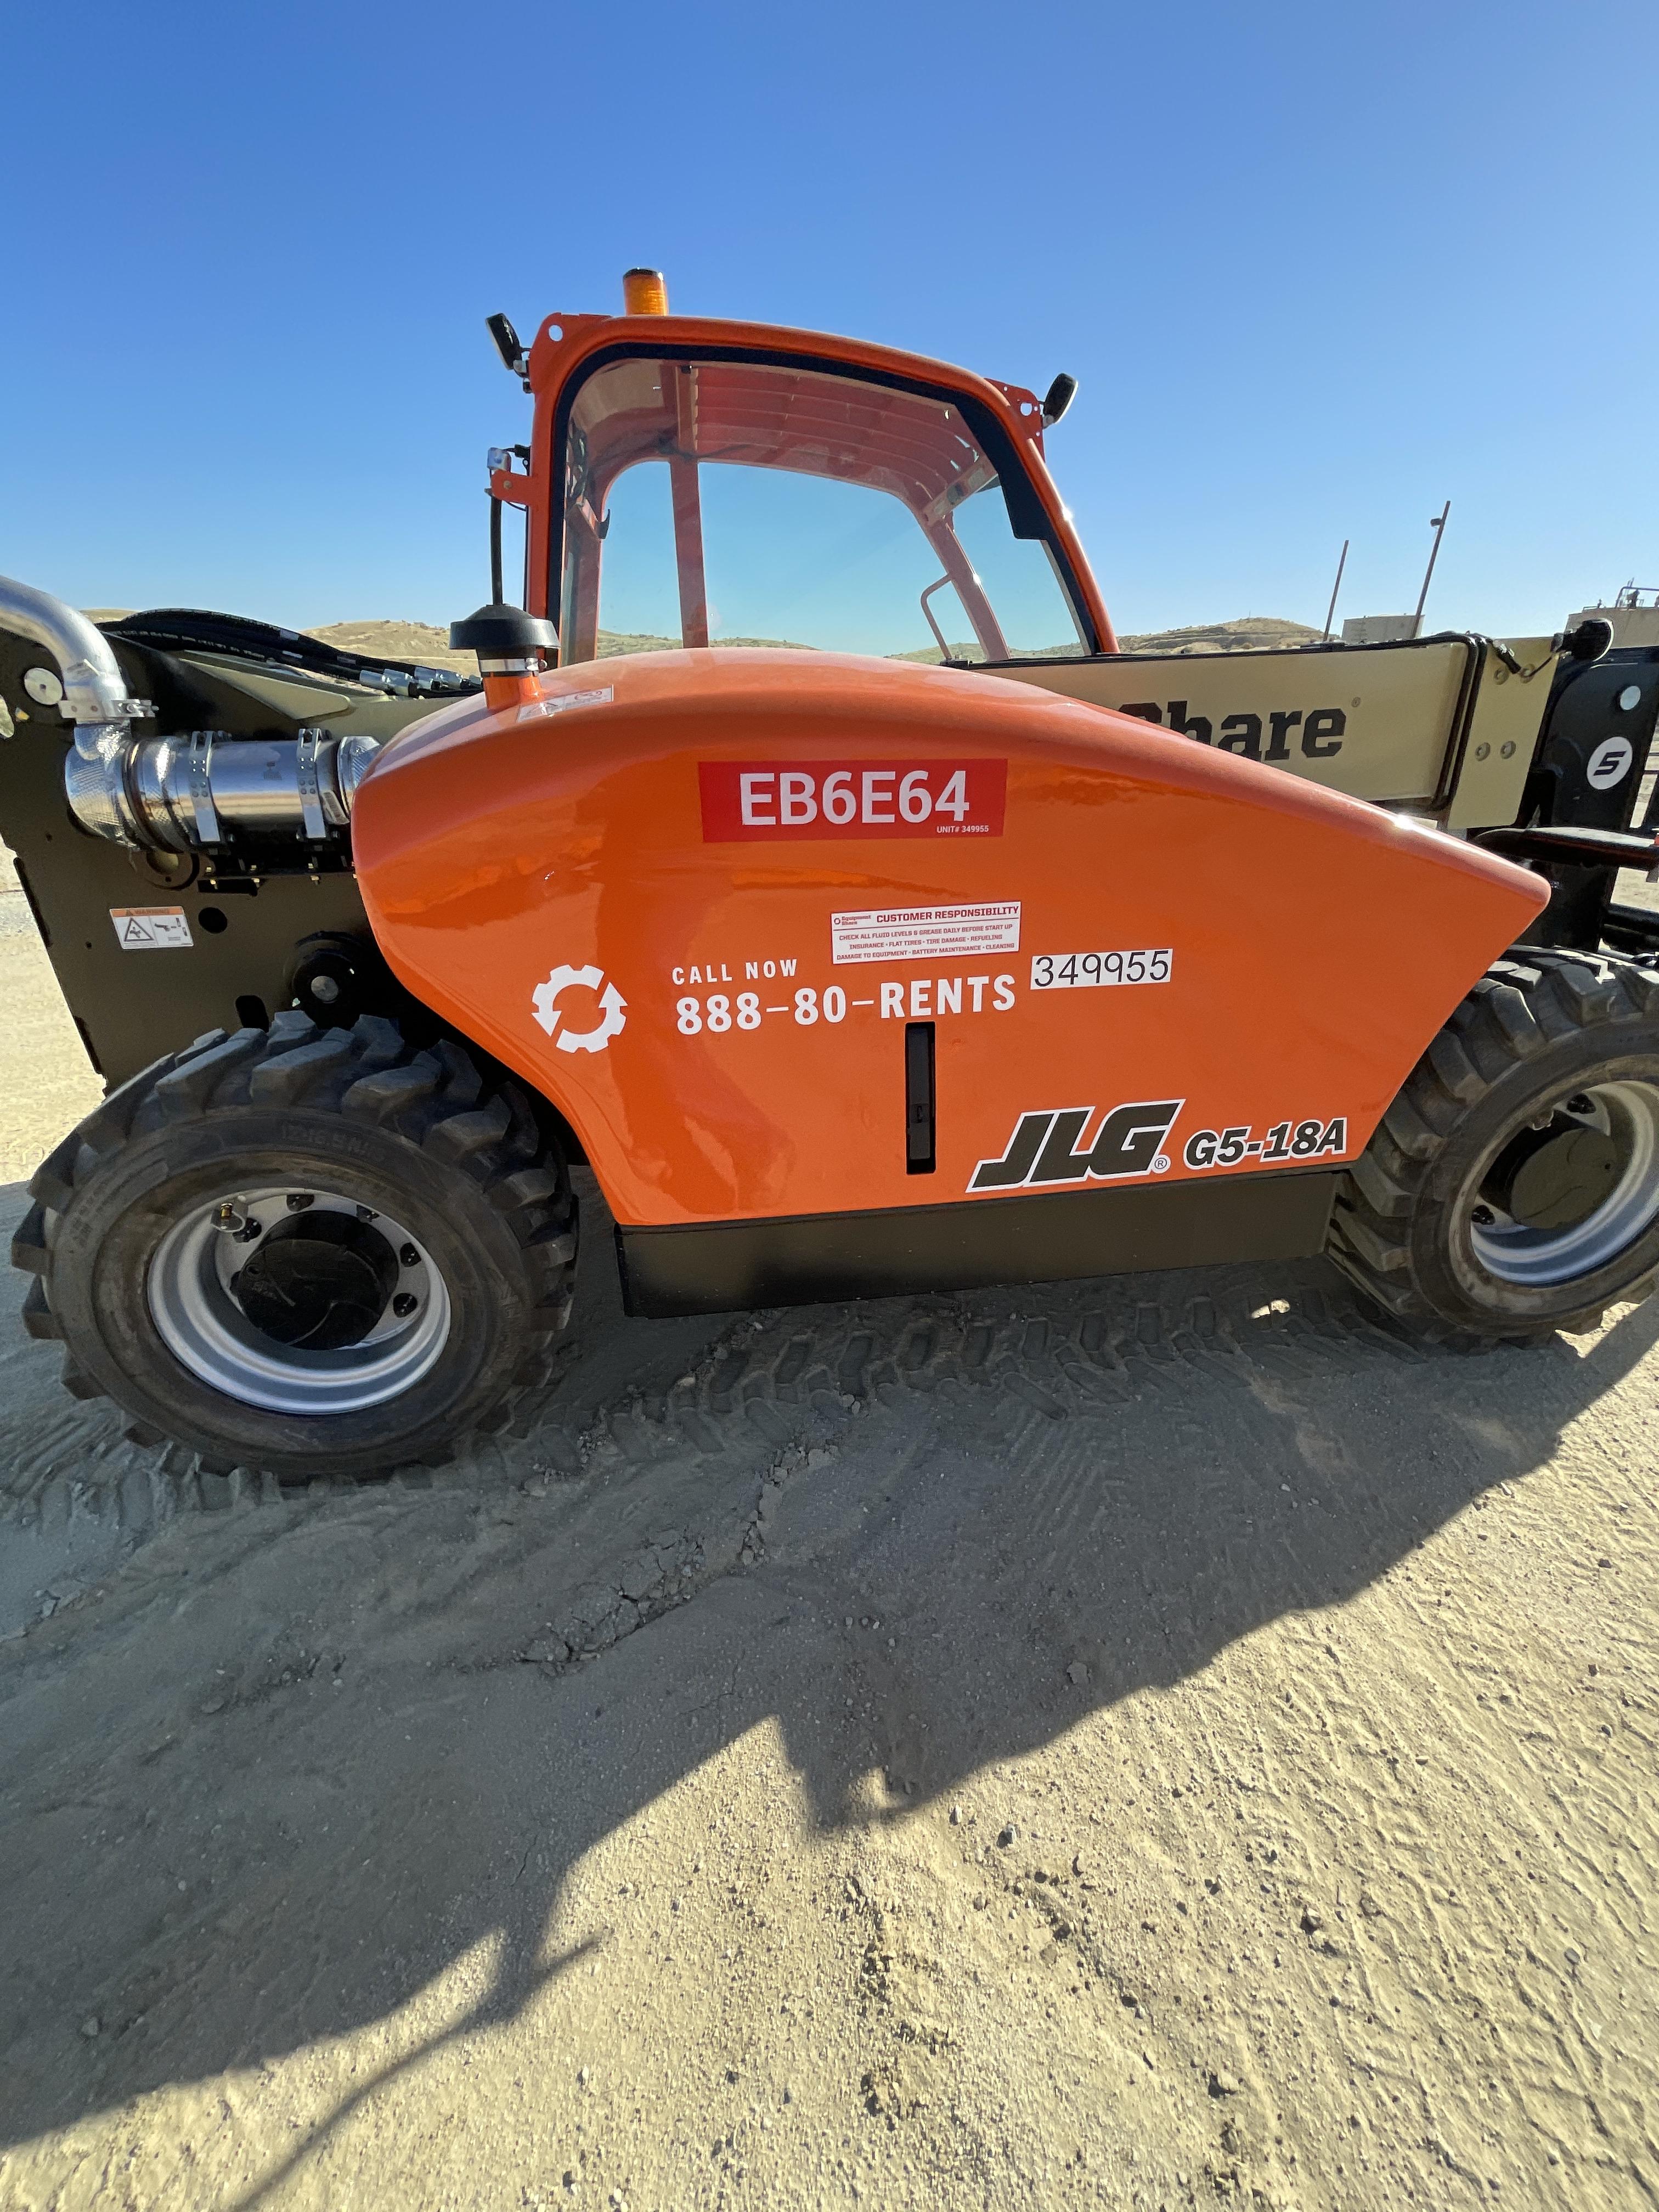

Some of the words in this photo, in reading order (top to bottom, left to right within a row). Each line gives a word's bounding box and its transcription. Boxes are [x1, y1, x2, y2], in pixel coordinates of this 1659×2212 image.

[740, 770, 969, 825] EB6E64
[877, 912, 932, 923] CUSTOMER
[935, 906, 1019, 919] RESPONSIBILITY
[672, 964, 732, 985] CALL
[745, 959, 797, 979] NOW
[1034, 950, 1169, 987] 349955
[676, 974, 1015, 1035] 888-80-RENTS
[967, 1100, 1184, 1192] JLG
[1183, 1118, 1347, 1170] G5-18A
